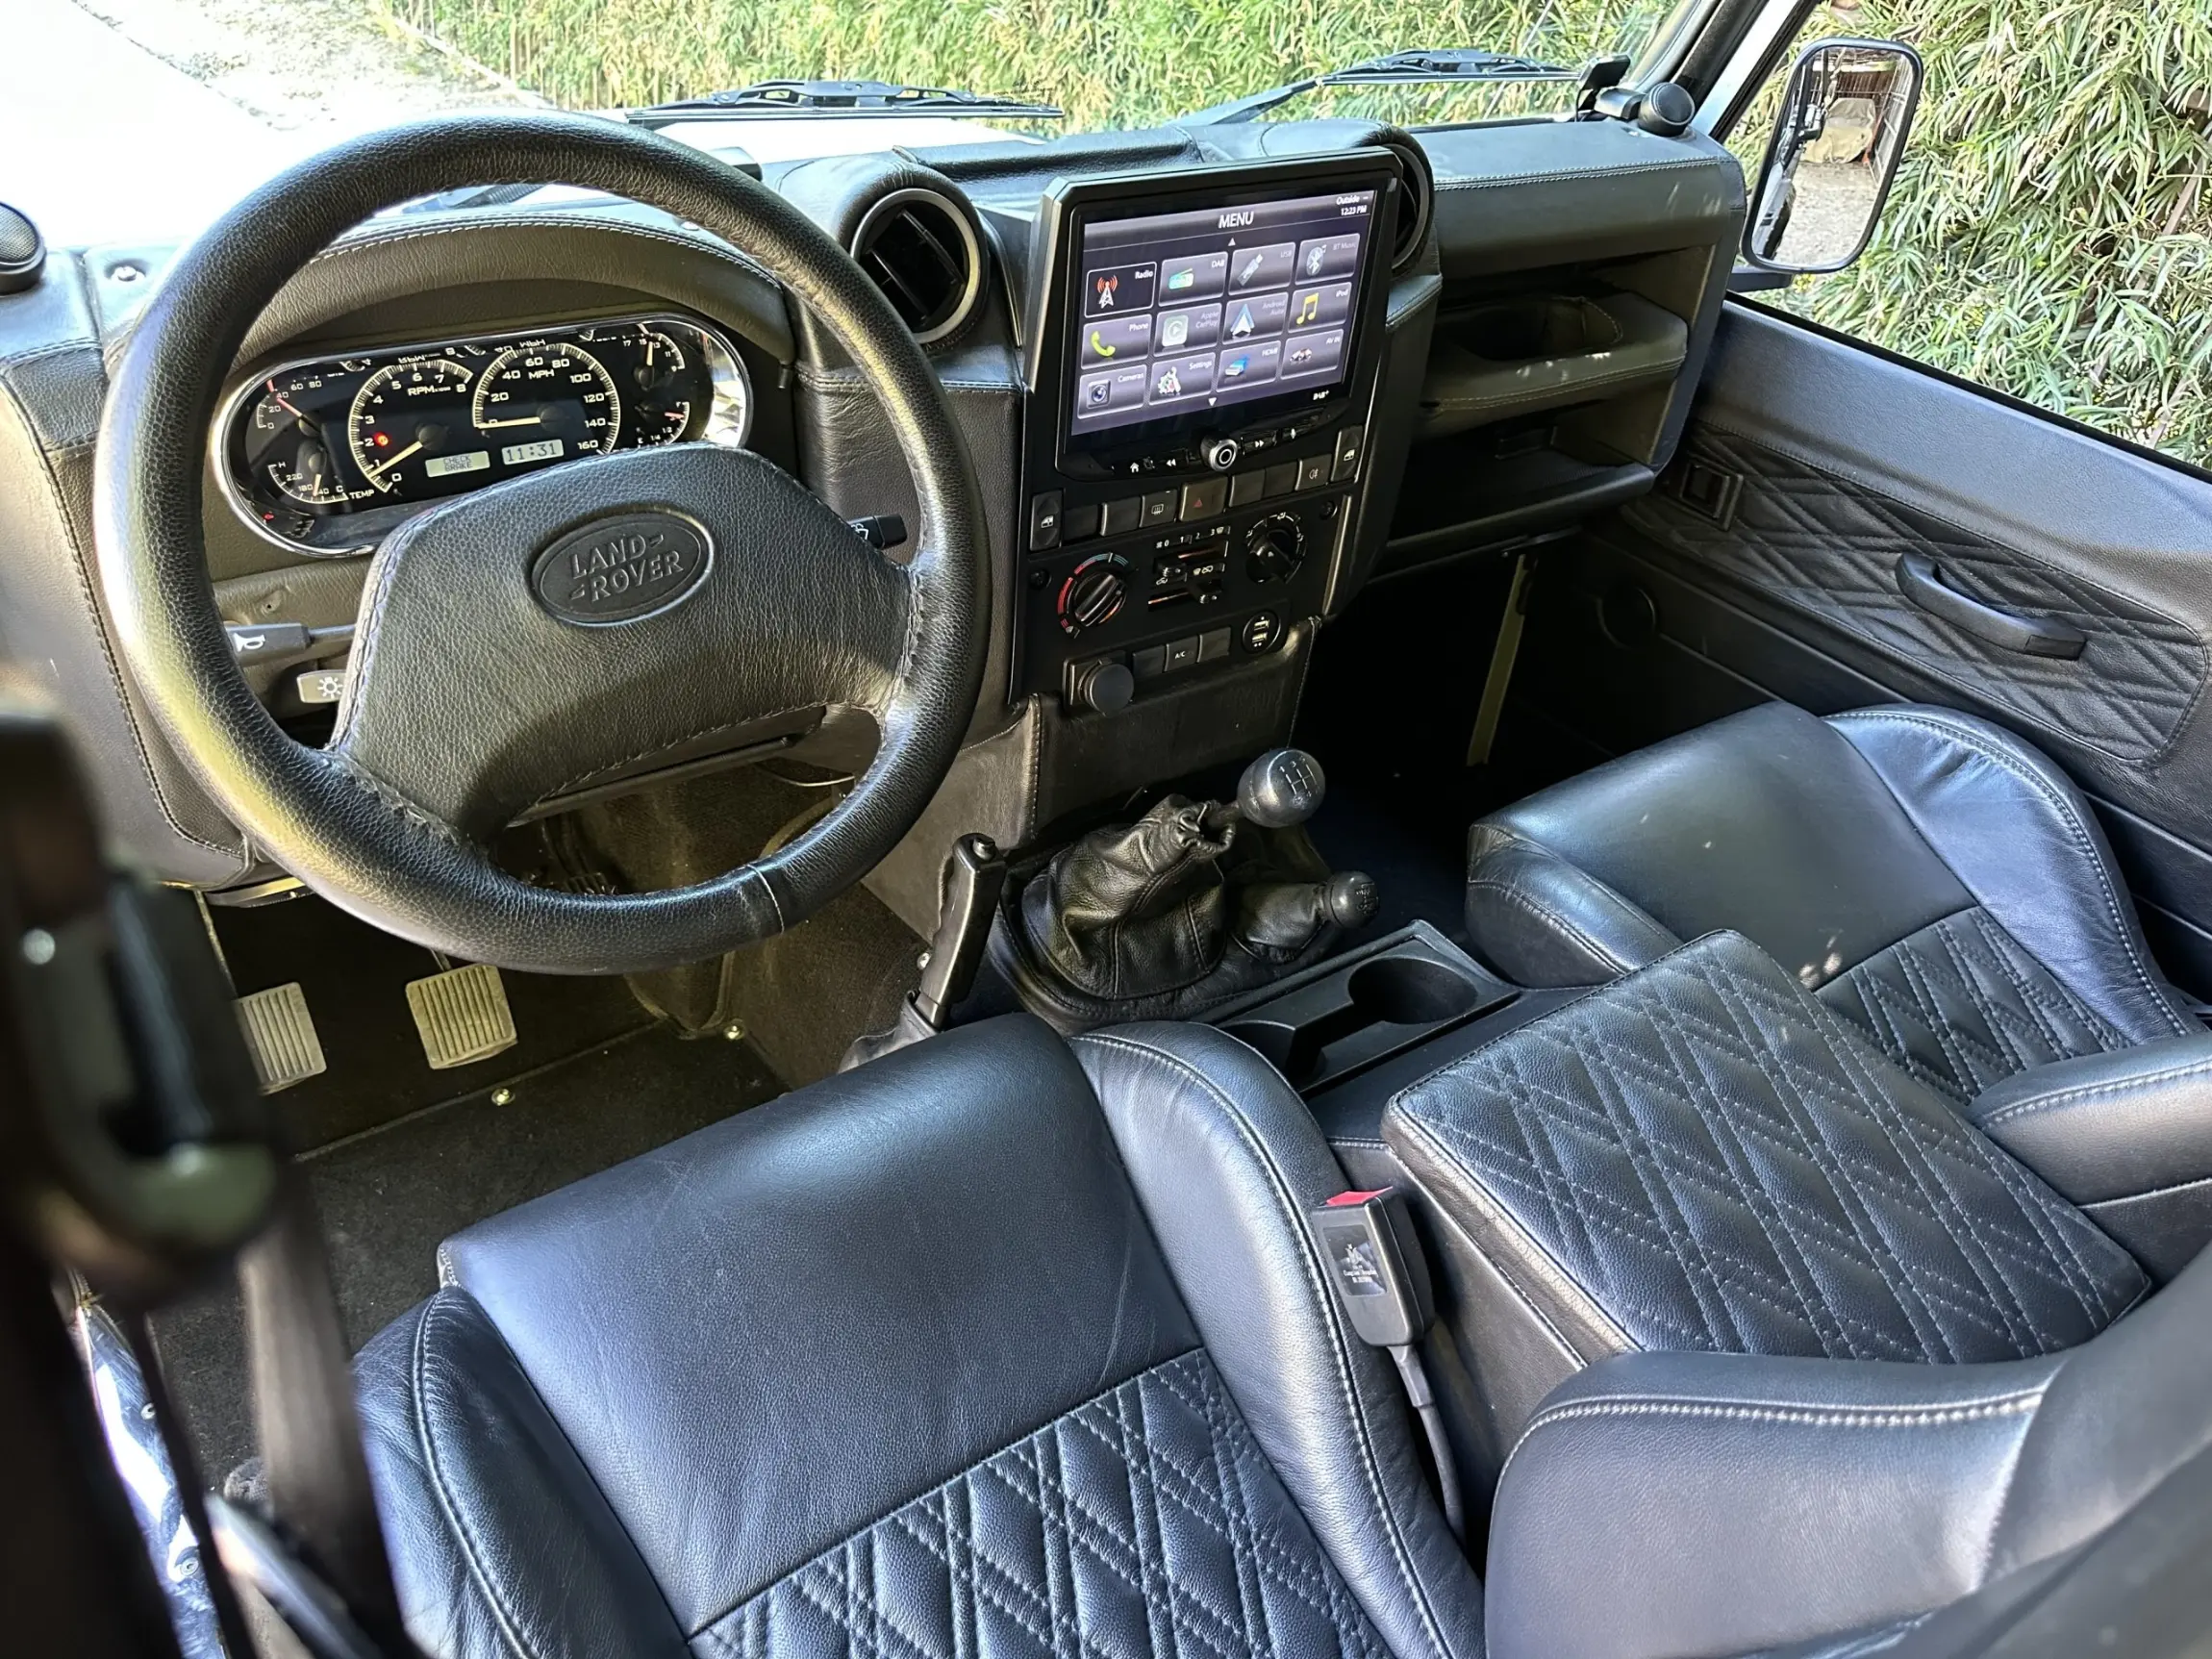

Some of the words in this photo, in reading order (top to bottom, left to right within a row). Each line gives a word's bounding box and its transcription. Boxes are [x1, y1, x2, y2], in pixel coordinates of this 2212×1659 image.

[1336, 195, 1361, 206] Outside
[1357, 205, 1368, 214] PM
[1219, 212, 1254, 229] MENU
[1211, 260, 1225, 268] DAB
[1135, 270, 1154, 280] Radio
[1262, 300, 1285, 309] Android
[1201, 312, 1219, 320] Apple
[1129, 323, 1149, 332] Phone
[1195, 320, 1219, 329] CarPlay
[525, 357, 544, 367] 60
[551, 358, 570, 368] 80
[1189, 361, 1213, 370] Settings
[412, 372, 422, 382] 6
[434, 374, 444, 383] 7
[501, 369, 521, 380] 40
[528, 368, 555, 380] MPH
[569, 373, 592, 384] 100
[1118, 373, 1144, 383] Cameras
[309, 380, 322, 389] 80
[391, 381, 402, 390] 5
[456, 384, 466, 392] 8
[372, 395, 384, 404] 4
[490, 391, 510, 402] 20
[583, 392, 605, 403] 120
[268, 405, 282, 414] 20
[364, 415, 375, 424] 3
[585, 417, 606, 428] 140
[364, 438, 375, 446] 2
[577, 440, 599, 450] 160
[506, 442, 558, 463] 11:31
[444, 463, 473, 471] BRAKE
[286, 472, 303, 482] 220
[391, 473, 402, 482] 0
[336, 485, 344, 493] C
[349, 489, 375, 500] TEMP
[1164, 539, 1170, 547] 0
[1195, 532, 1201, 540] 2
[569, 534, 646, 579] LAND
[591, 550, 684, 602] ROVER
